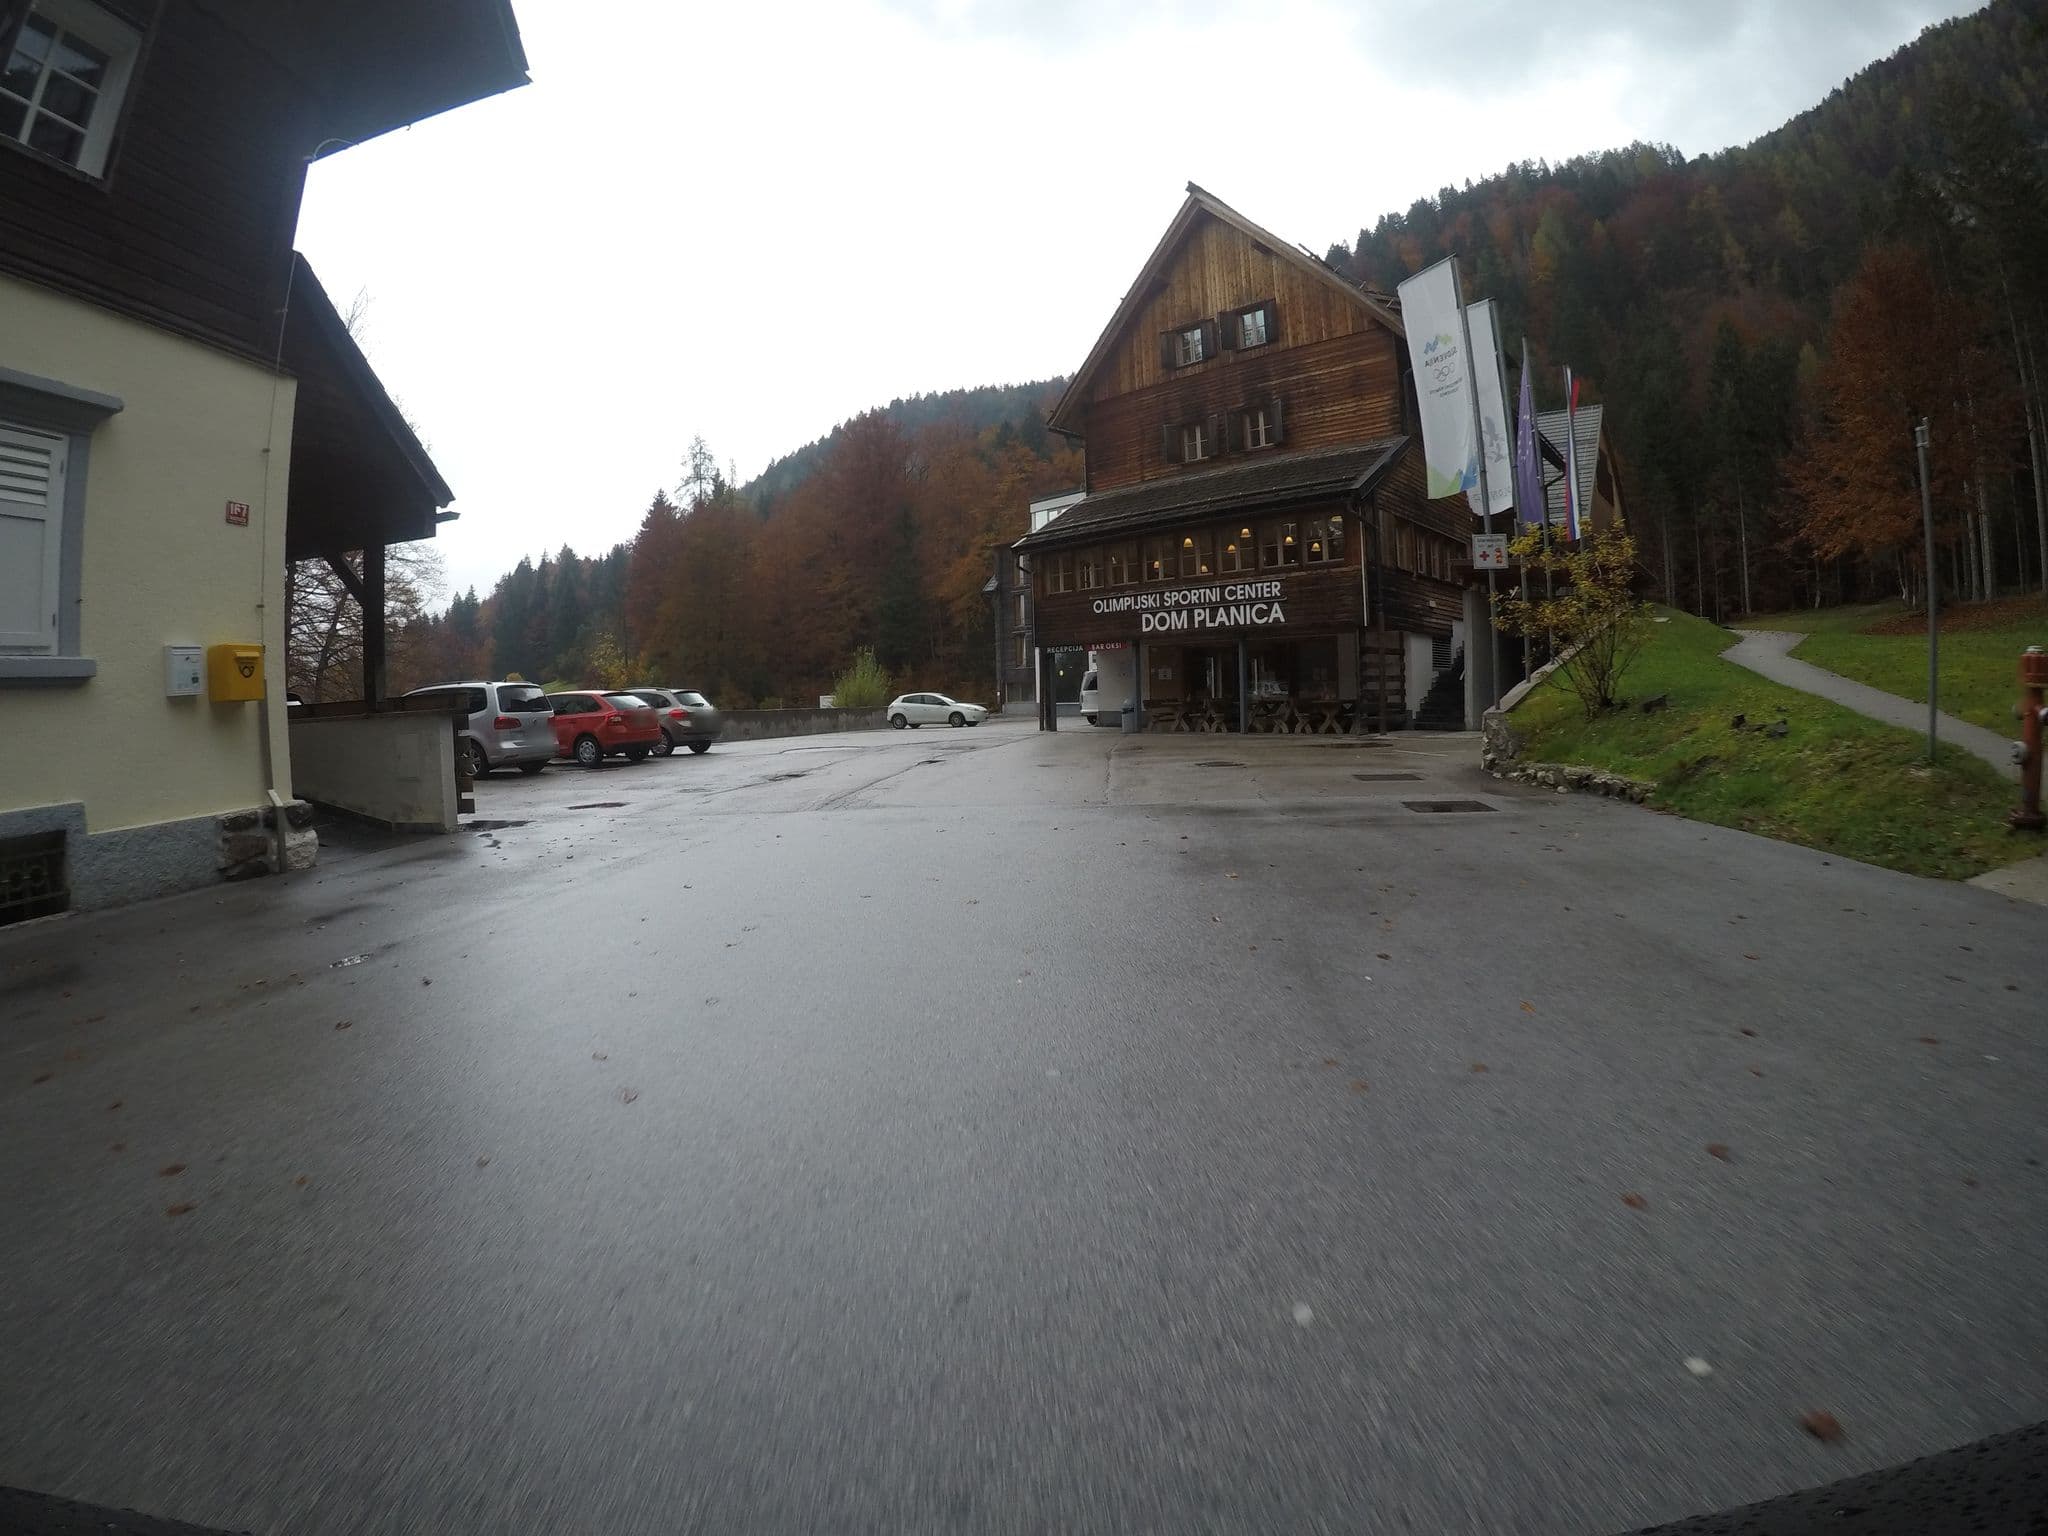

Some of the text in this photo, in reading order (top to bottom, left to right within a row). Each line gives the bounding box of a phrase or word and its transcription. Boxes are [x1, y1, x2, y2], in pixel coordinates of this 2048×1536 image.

[1093, 581, 1281, 614] OLIMPIJSKI SPORTNI CENTER
[1141, 602, 1286, 633] DOM PLANICA
[1046, 645, 1084, 654] RECEPCIJA
